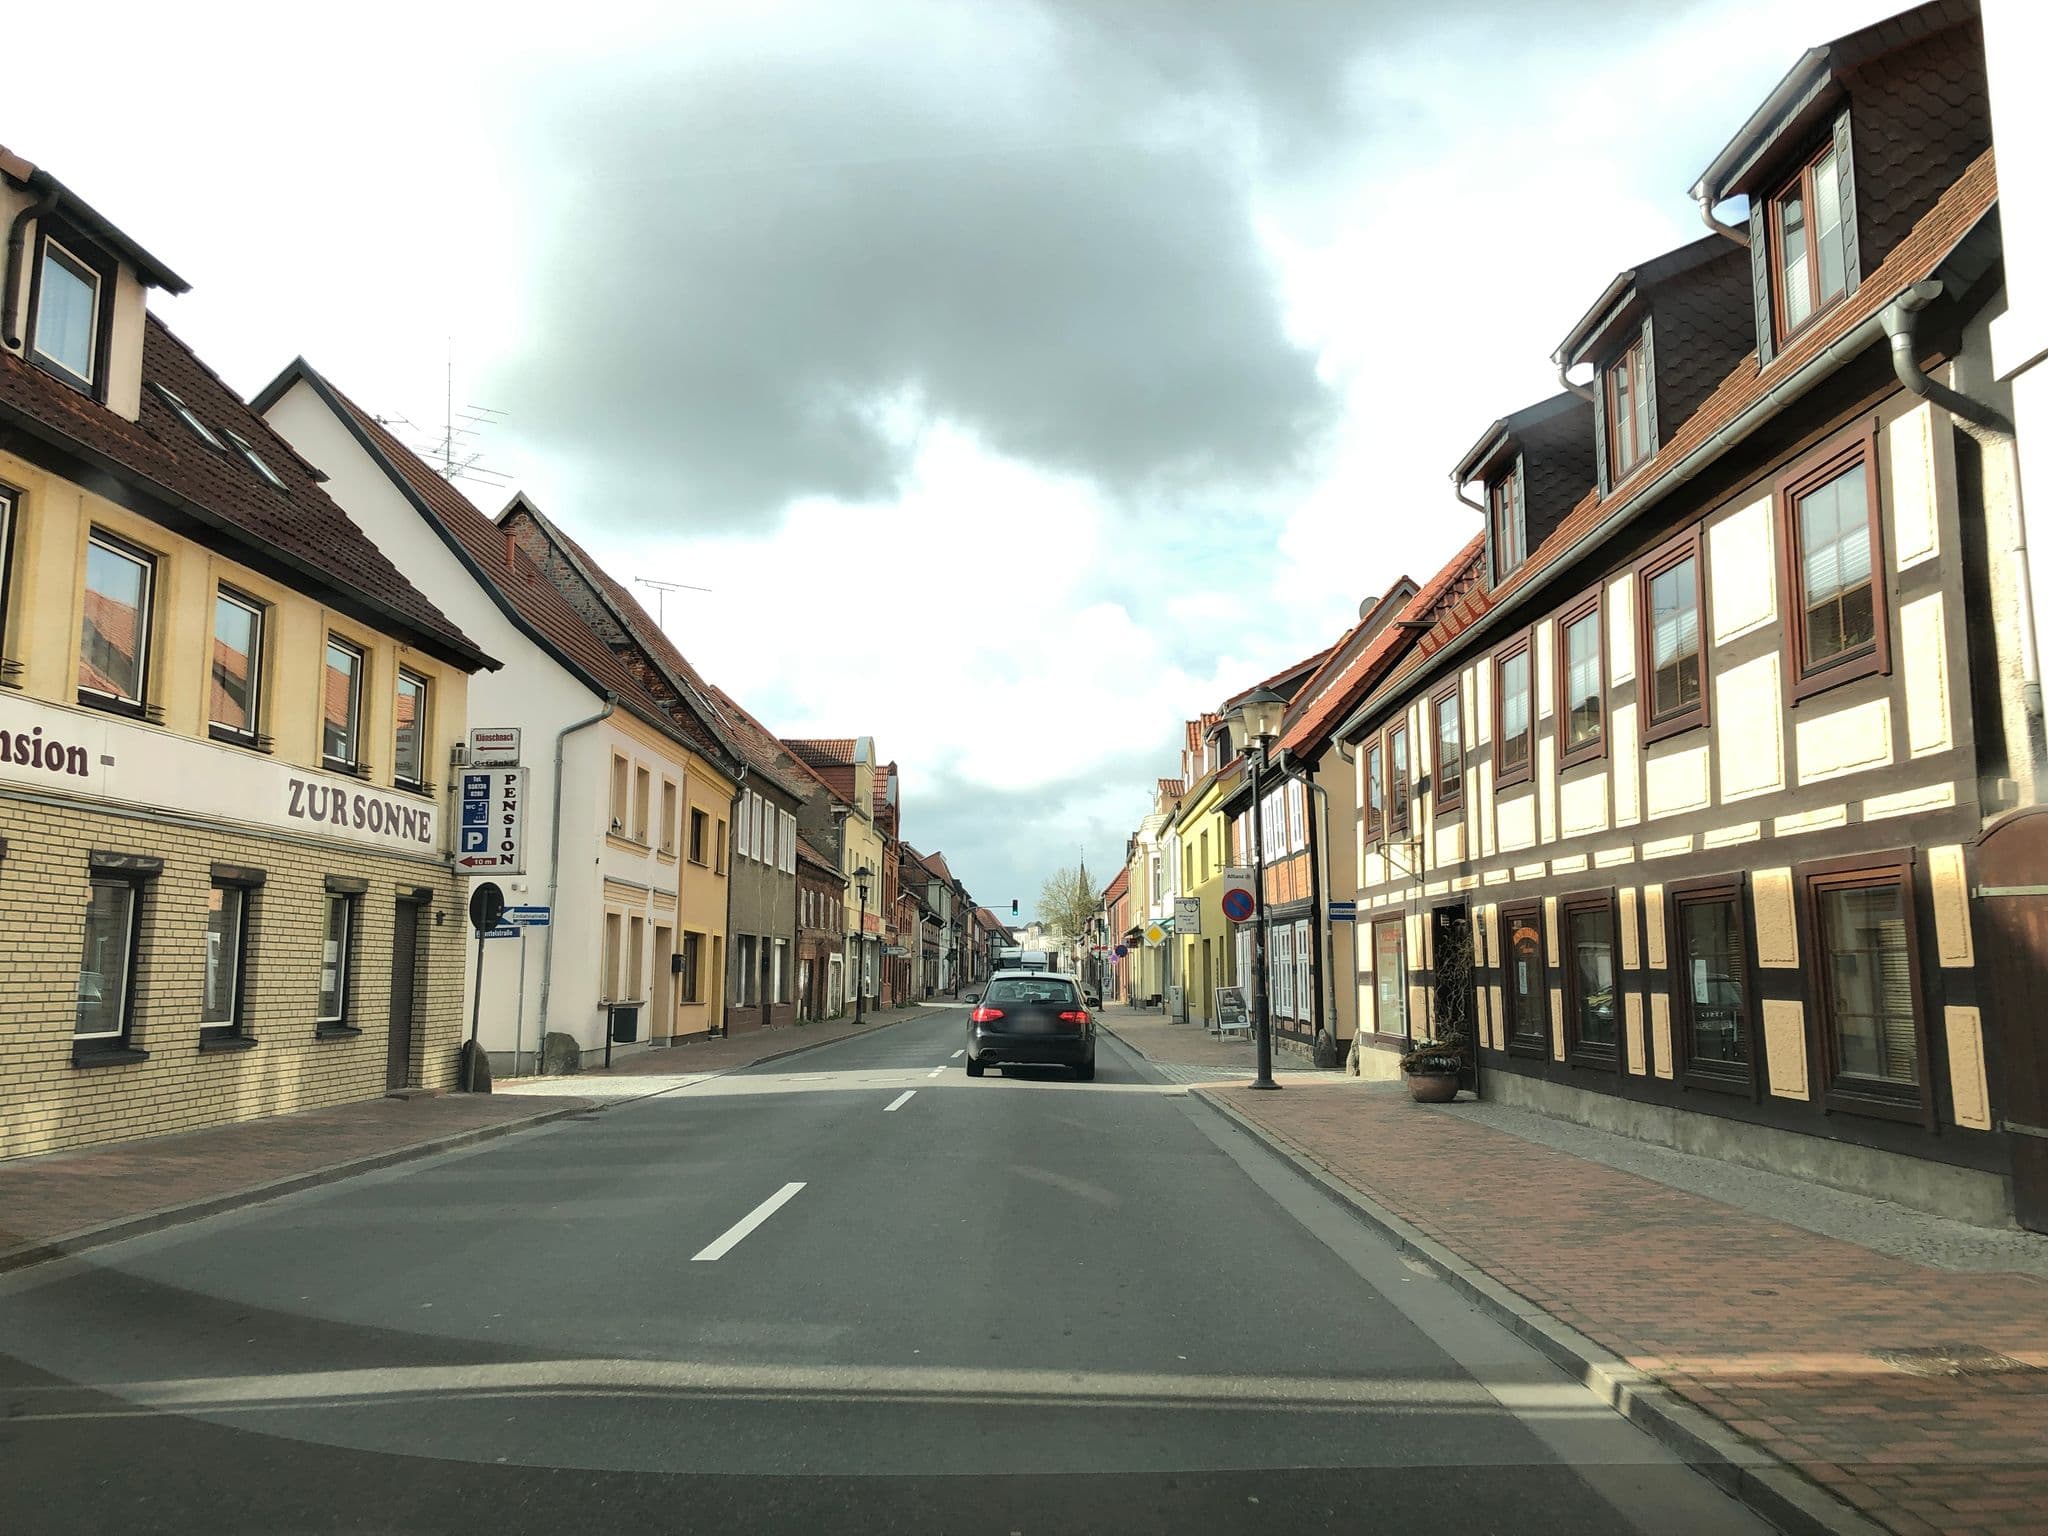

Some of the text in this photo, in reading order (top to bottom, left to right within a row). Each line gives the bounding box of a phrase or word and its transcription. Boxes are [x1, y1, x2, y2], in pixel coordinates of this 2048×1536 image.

[288, 778, 431, 844] ZUR SONNE
[467, 832, 483, 850] P
[500, 774, 517, 865] PENSION
